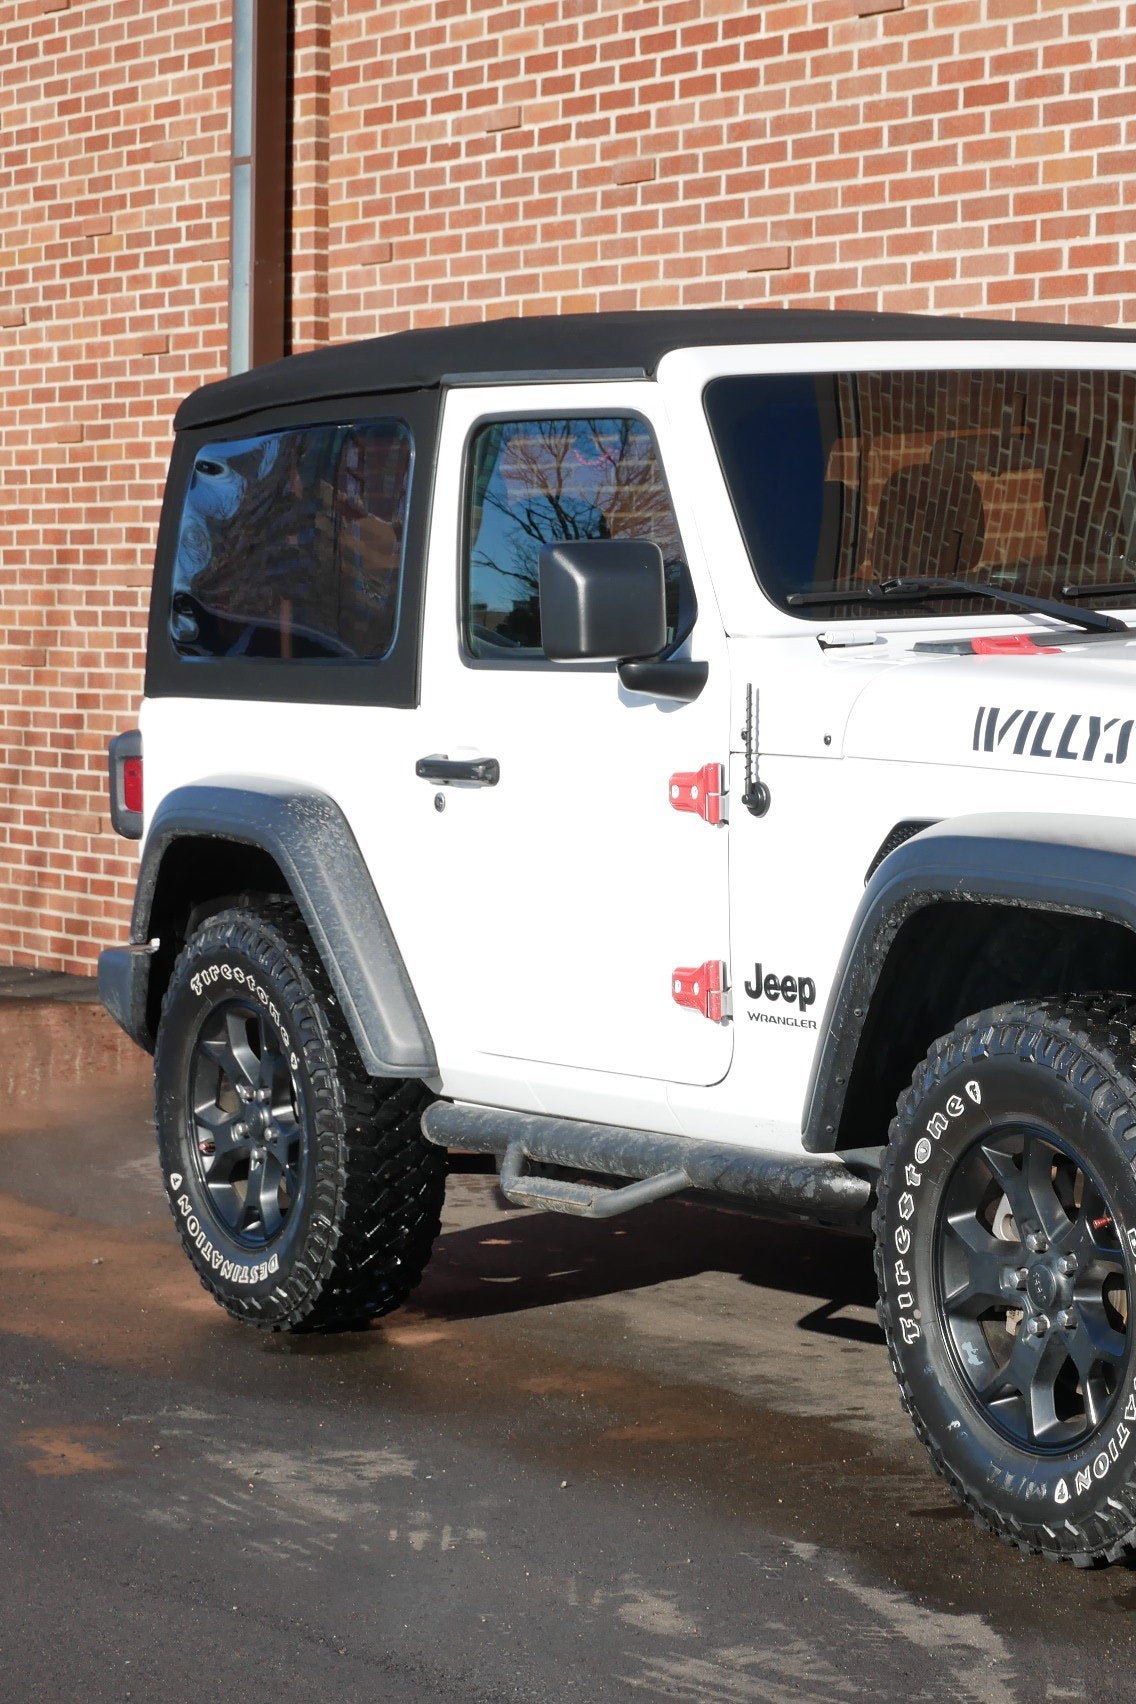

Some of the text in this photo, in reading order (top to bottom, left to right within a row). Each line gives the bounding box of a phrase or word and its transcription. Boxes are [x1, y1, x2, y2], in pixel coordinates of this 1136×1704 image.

[190, 964, 291, 1046] Firestone
[744, 962, 816, 1012] Jeep
[747, 1011, 817, 1029] WRANGLER
[176, 1194, 280, 1284] DESTINATION
[894, 1094, 964, 1345] Firestone
